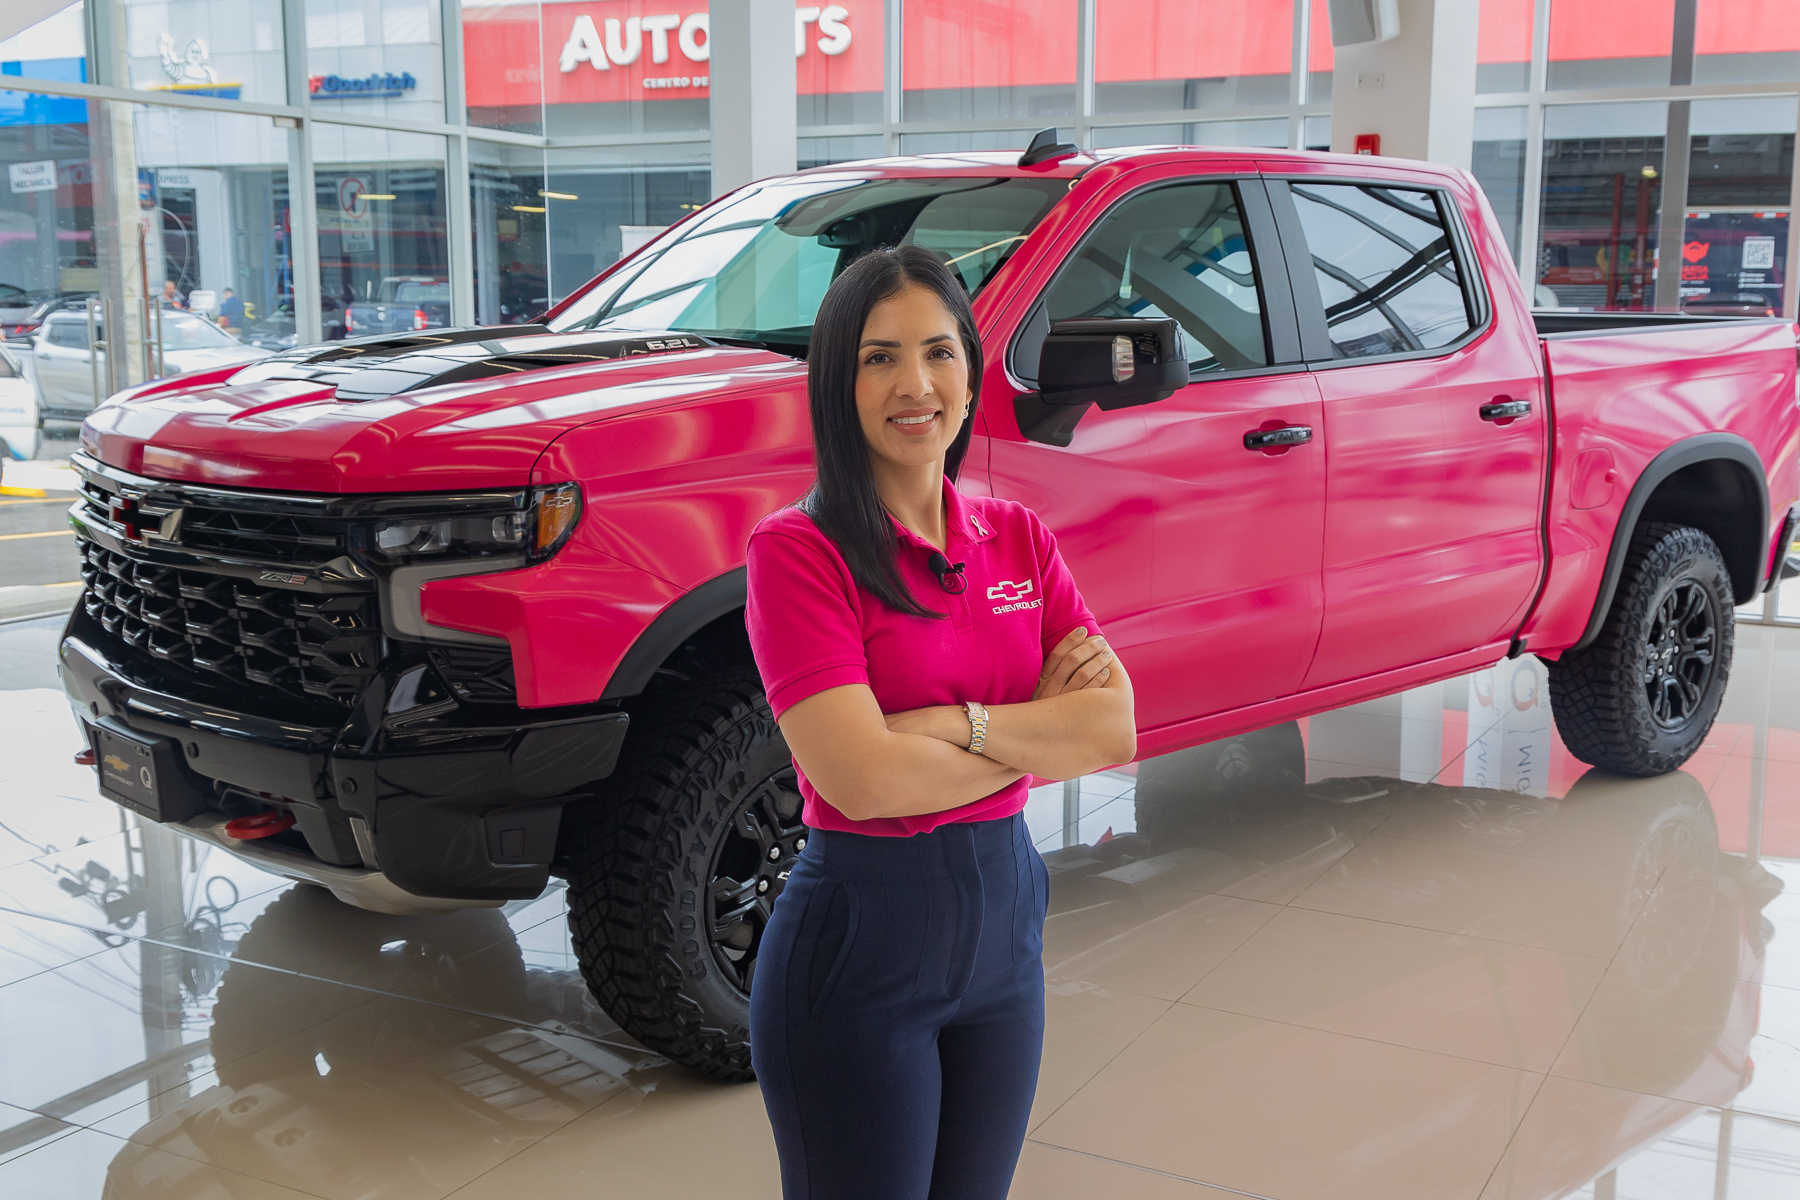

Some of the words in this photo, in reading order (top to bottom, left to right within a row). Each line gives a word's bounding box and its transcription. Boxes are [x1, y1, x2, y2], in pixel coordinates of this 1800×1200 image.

[559, 5, 852, 73] AUTOTS
[308, 71, 416, 93] FGoodrich
[643, 77, 691, 89] CENTRO
[17, 165, 45, 175] TALLER
[13, 178, 51, 188] MECANICA
[646, 338, 699, 351] 6.2L
[260, 570, 307, 585] ZR2
[992, 598, 1042, 614] CHEVROLET
[103, 769, 134, 787] CHEVROLET
[140, 766, 152, 790] Q
